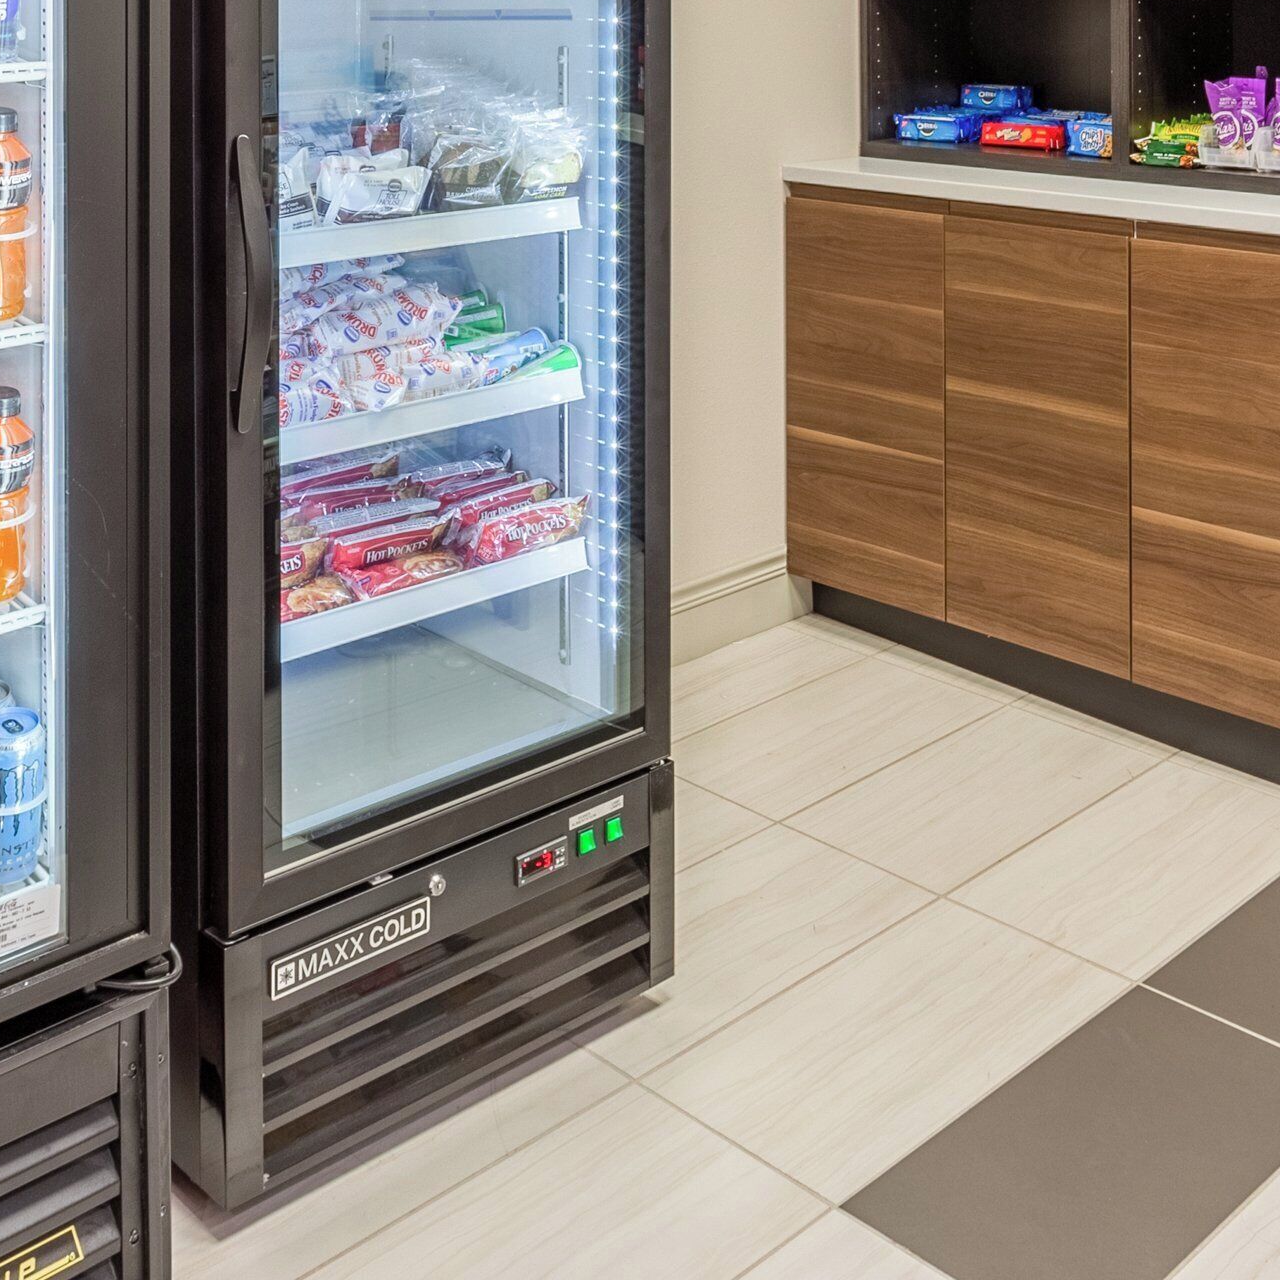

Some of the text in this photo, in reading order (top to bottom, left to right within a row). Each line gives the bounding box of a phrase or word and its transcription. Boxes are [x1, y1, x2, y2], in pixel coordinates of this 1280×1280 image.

[380, 197, 402, 207] HOUSE
[386, 192, 402, 200] TOLL
[498, 497, 533, 516] POCKETS
[525, 514, 568, 536] POCKETS
[366, 538, 428, 563] HOT POCKETS
[298, 906, 426, 982] MAXX COLD
